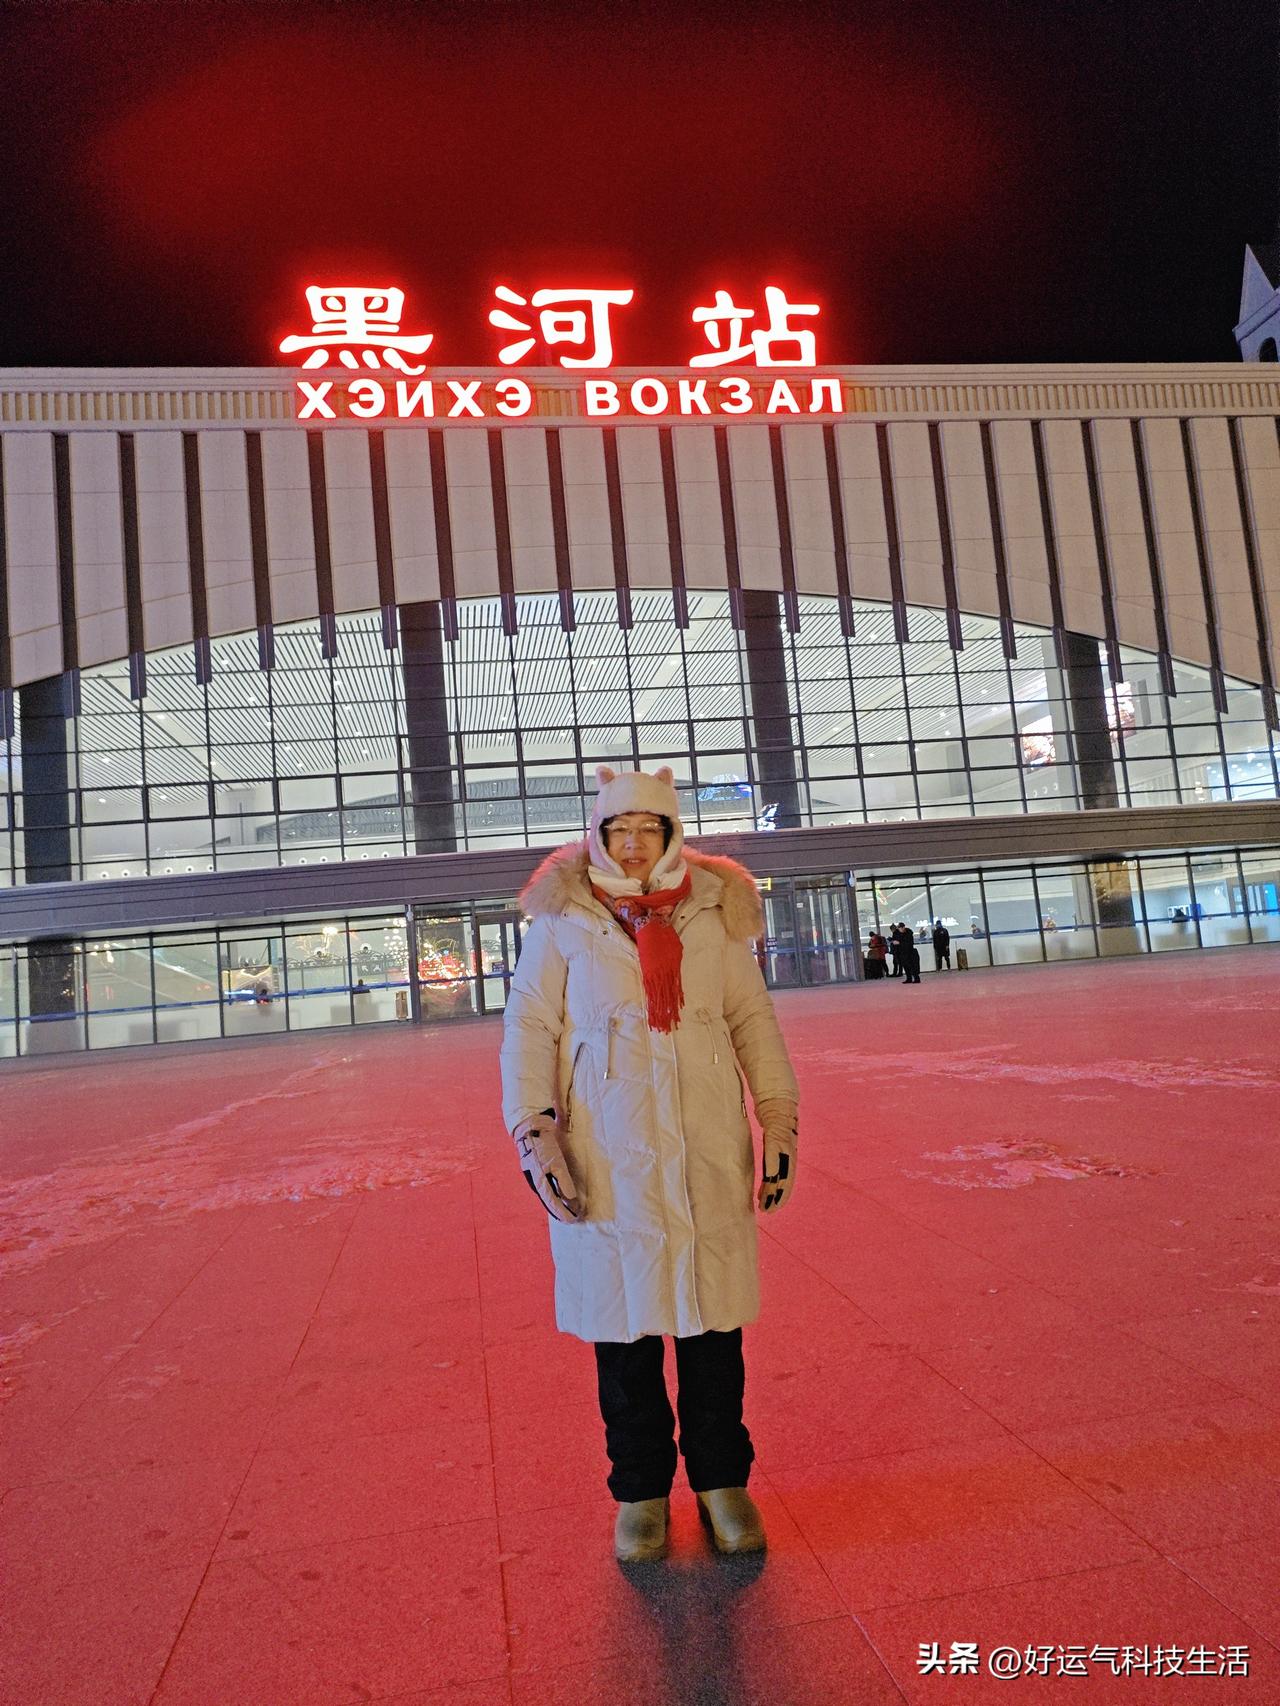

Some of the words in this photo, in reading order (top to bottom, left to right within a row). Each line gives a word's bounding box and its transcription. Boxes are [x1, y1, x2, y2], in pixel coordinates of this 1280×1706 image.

[279, 285, 821, 376] 黑河站
[296, 378, 532, 419] ХЭИХЭ
[584, 377, 843, 416] ВОКЗАЛ
